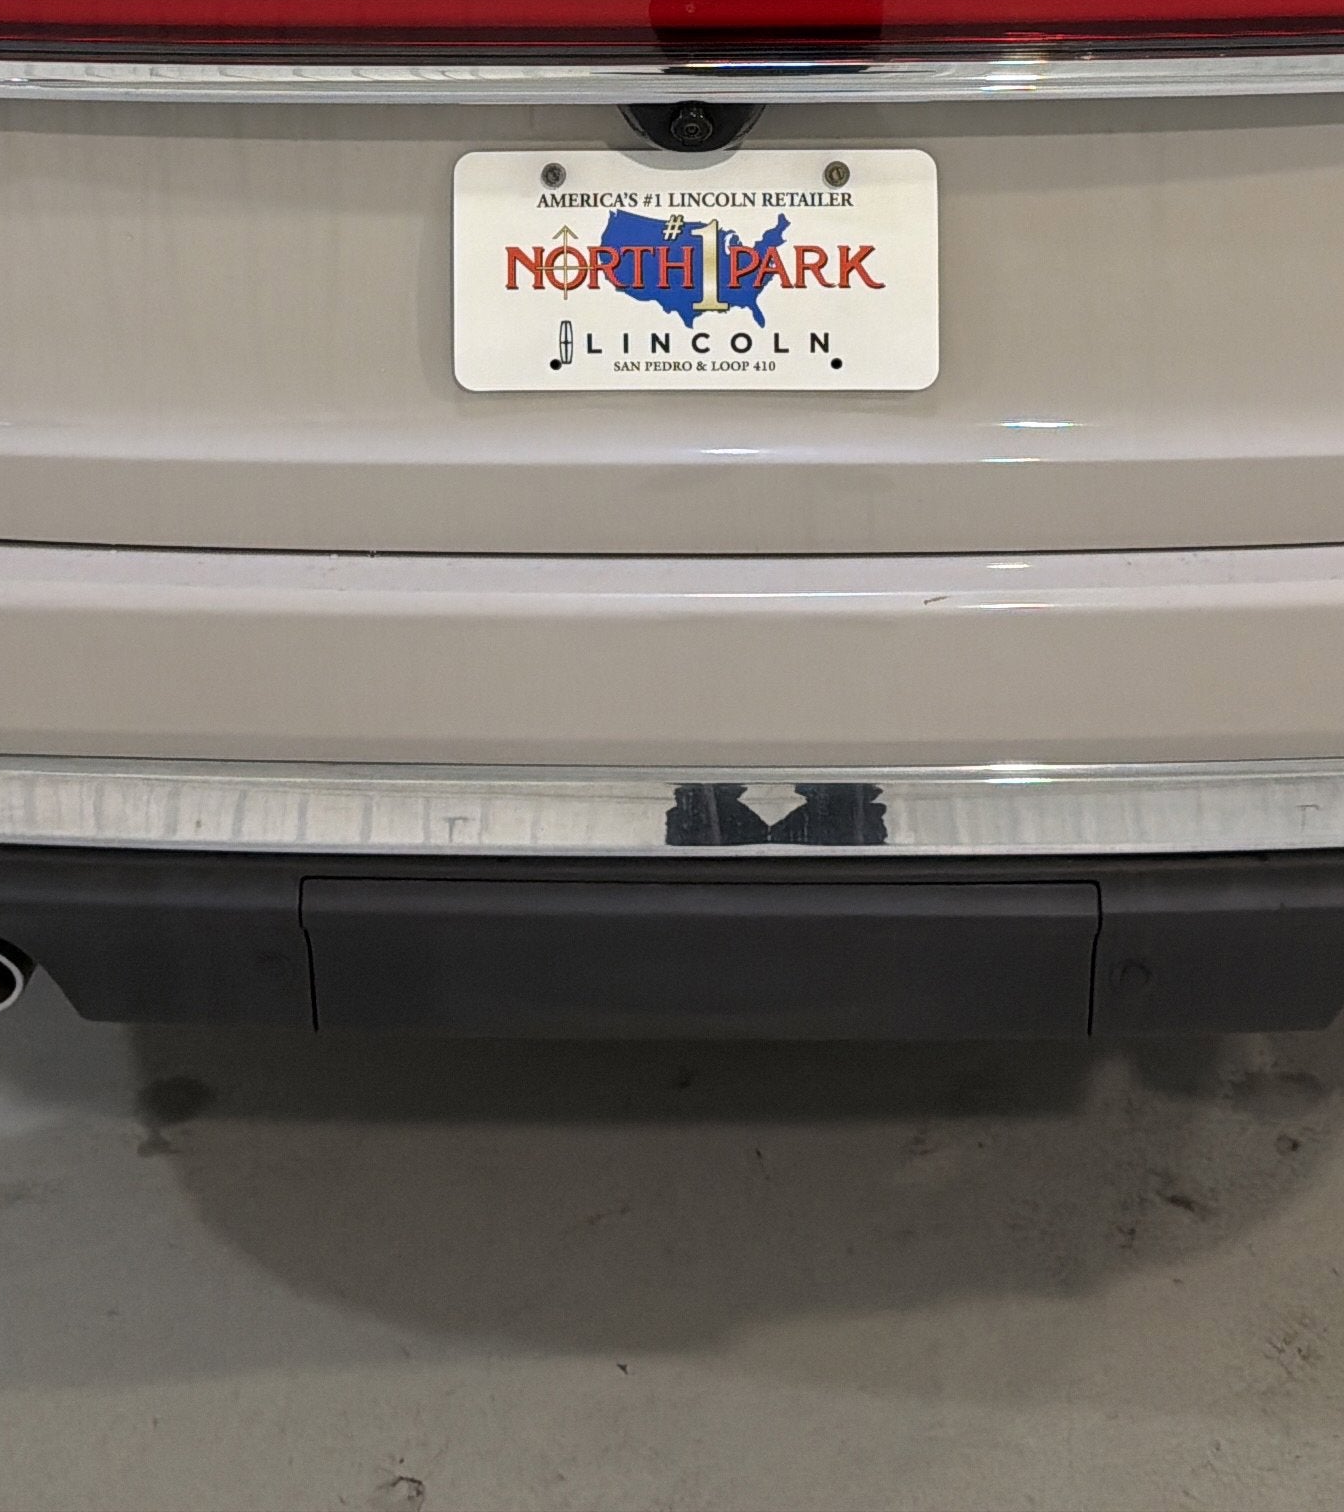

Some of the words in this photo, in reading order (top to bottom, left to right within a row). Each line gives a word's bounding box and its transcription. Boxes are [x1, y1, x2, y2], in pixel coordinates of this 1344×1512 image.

[536, 191, 639, 209] AMERICA'S
[643, 192, 662, 208] #1
[668, 191, 757, 208] LINCOLN
[761, 191, 855, 208] RETAILER
[505, 245, 697, 290] NORTH
[728, 244, 887, 290] PARK
[586, 332, 831, 355] LINCOLN
[613, 360, 642, 373] SAN
[644, 360, 693, 373] PEDRO
[696, 361, 709, 373] &
[711, 360, 751, 372] LOOP
[752, 360, 777, 372] 410
